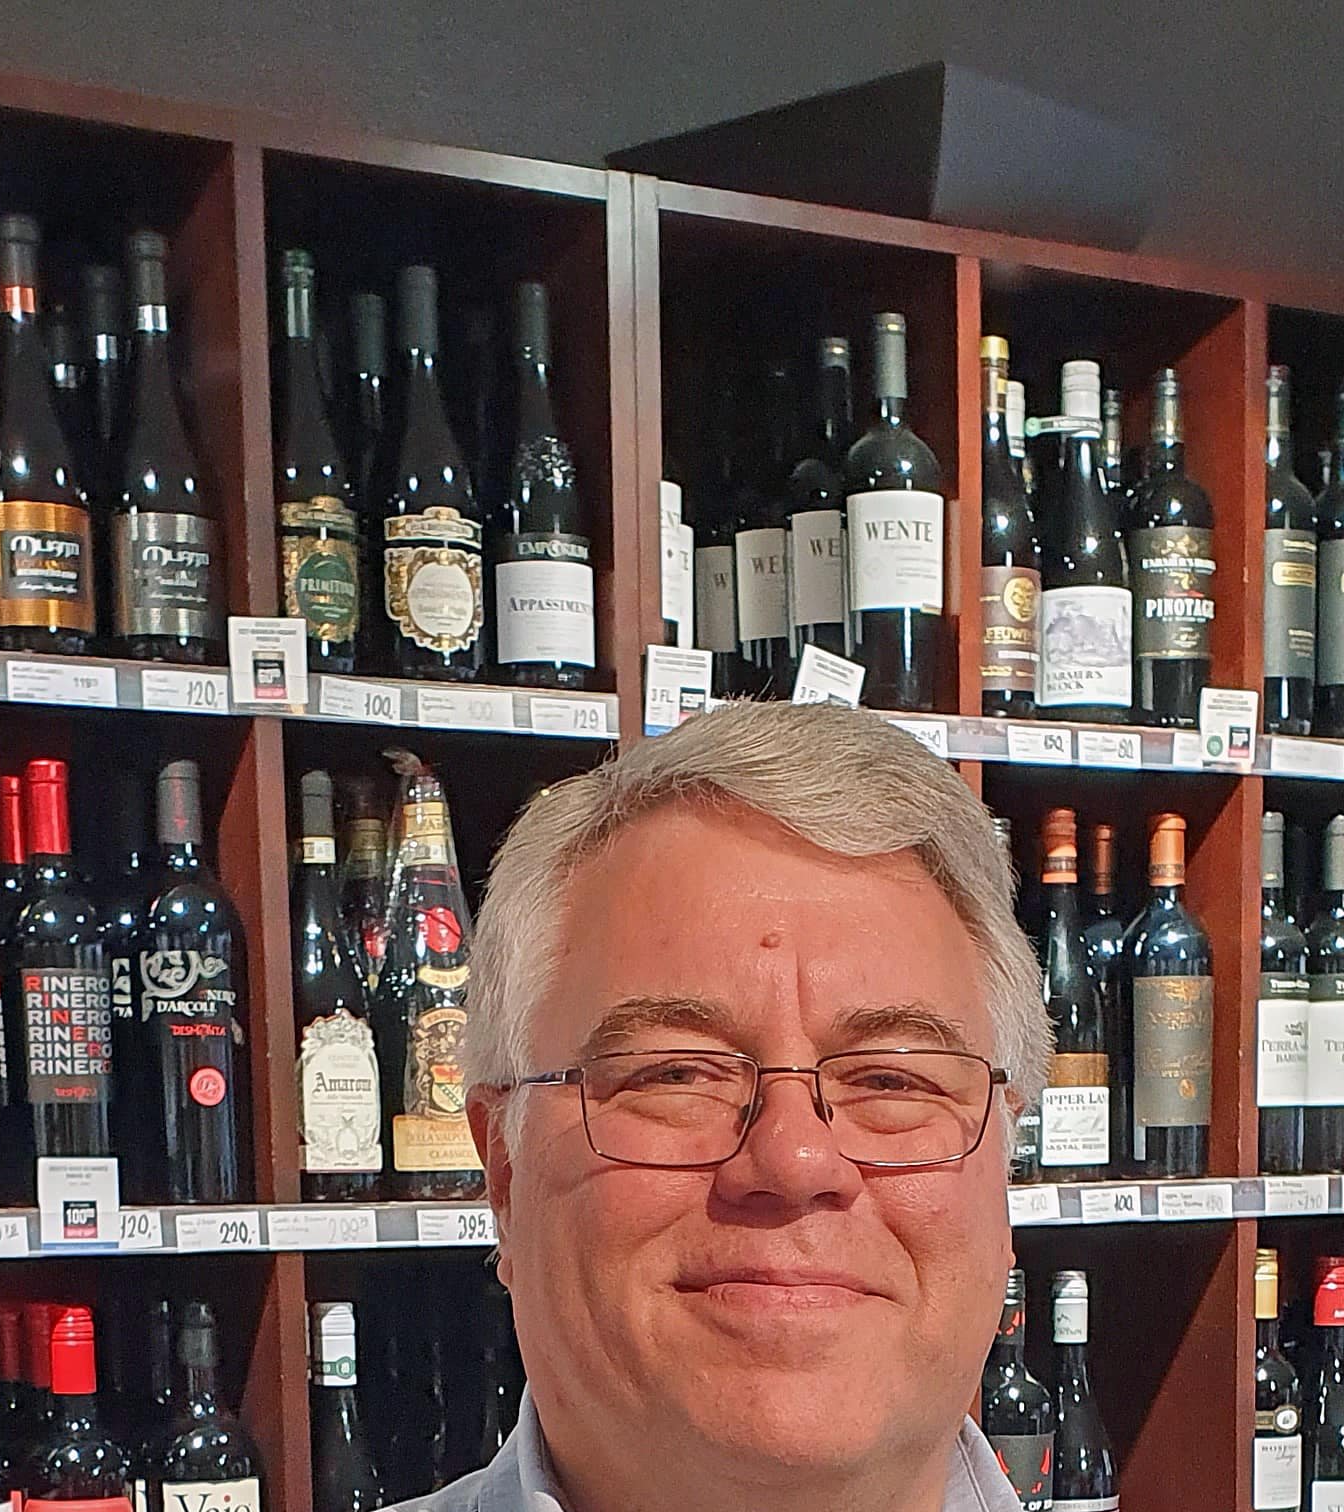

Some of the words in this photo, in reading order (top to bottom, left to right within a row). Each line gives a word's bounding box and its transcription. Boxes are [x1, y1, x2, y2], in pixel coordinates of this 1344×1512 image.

[865, 520, 934, 543] WENTE
[24, 976, 111, 993] RINERO
[27, 993, 111, 1009] RINERO
[27, 1009, 112, 1026] RINERO
[28, 1026, 112, 1043] RINERO
[29, 1042, 113, 1060] RINERO
[30, 1059, 113, 1076] RINERO
